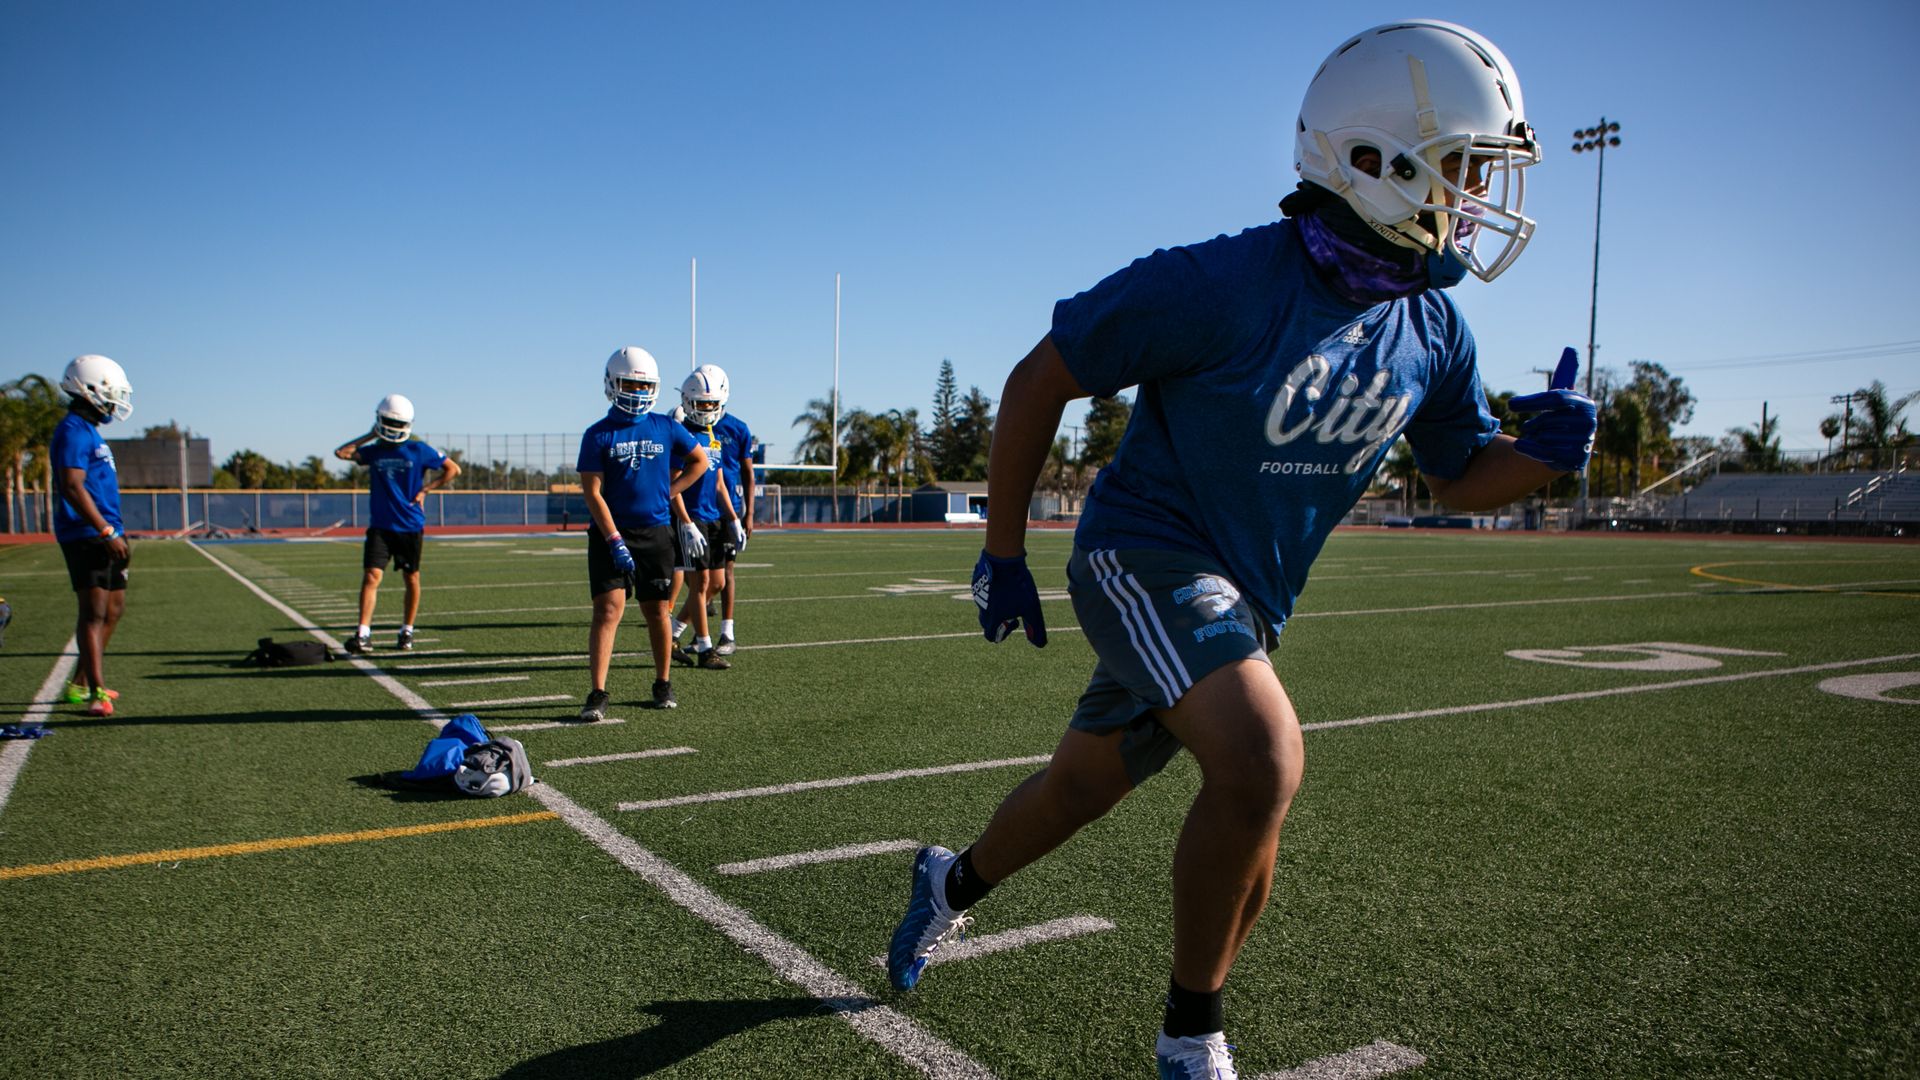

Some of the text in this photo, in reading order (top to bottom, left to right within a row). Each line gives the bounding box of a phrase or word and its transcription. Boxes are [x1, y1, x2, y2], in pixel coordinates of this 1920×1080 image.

[1368, 219, 1400, 242] XENITH
[1265, 355, 1412, 473] City
[1259, 462, 1340, 475] FOOTBALL
